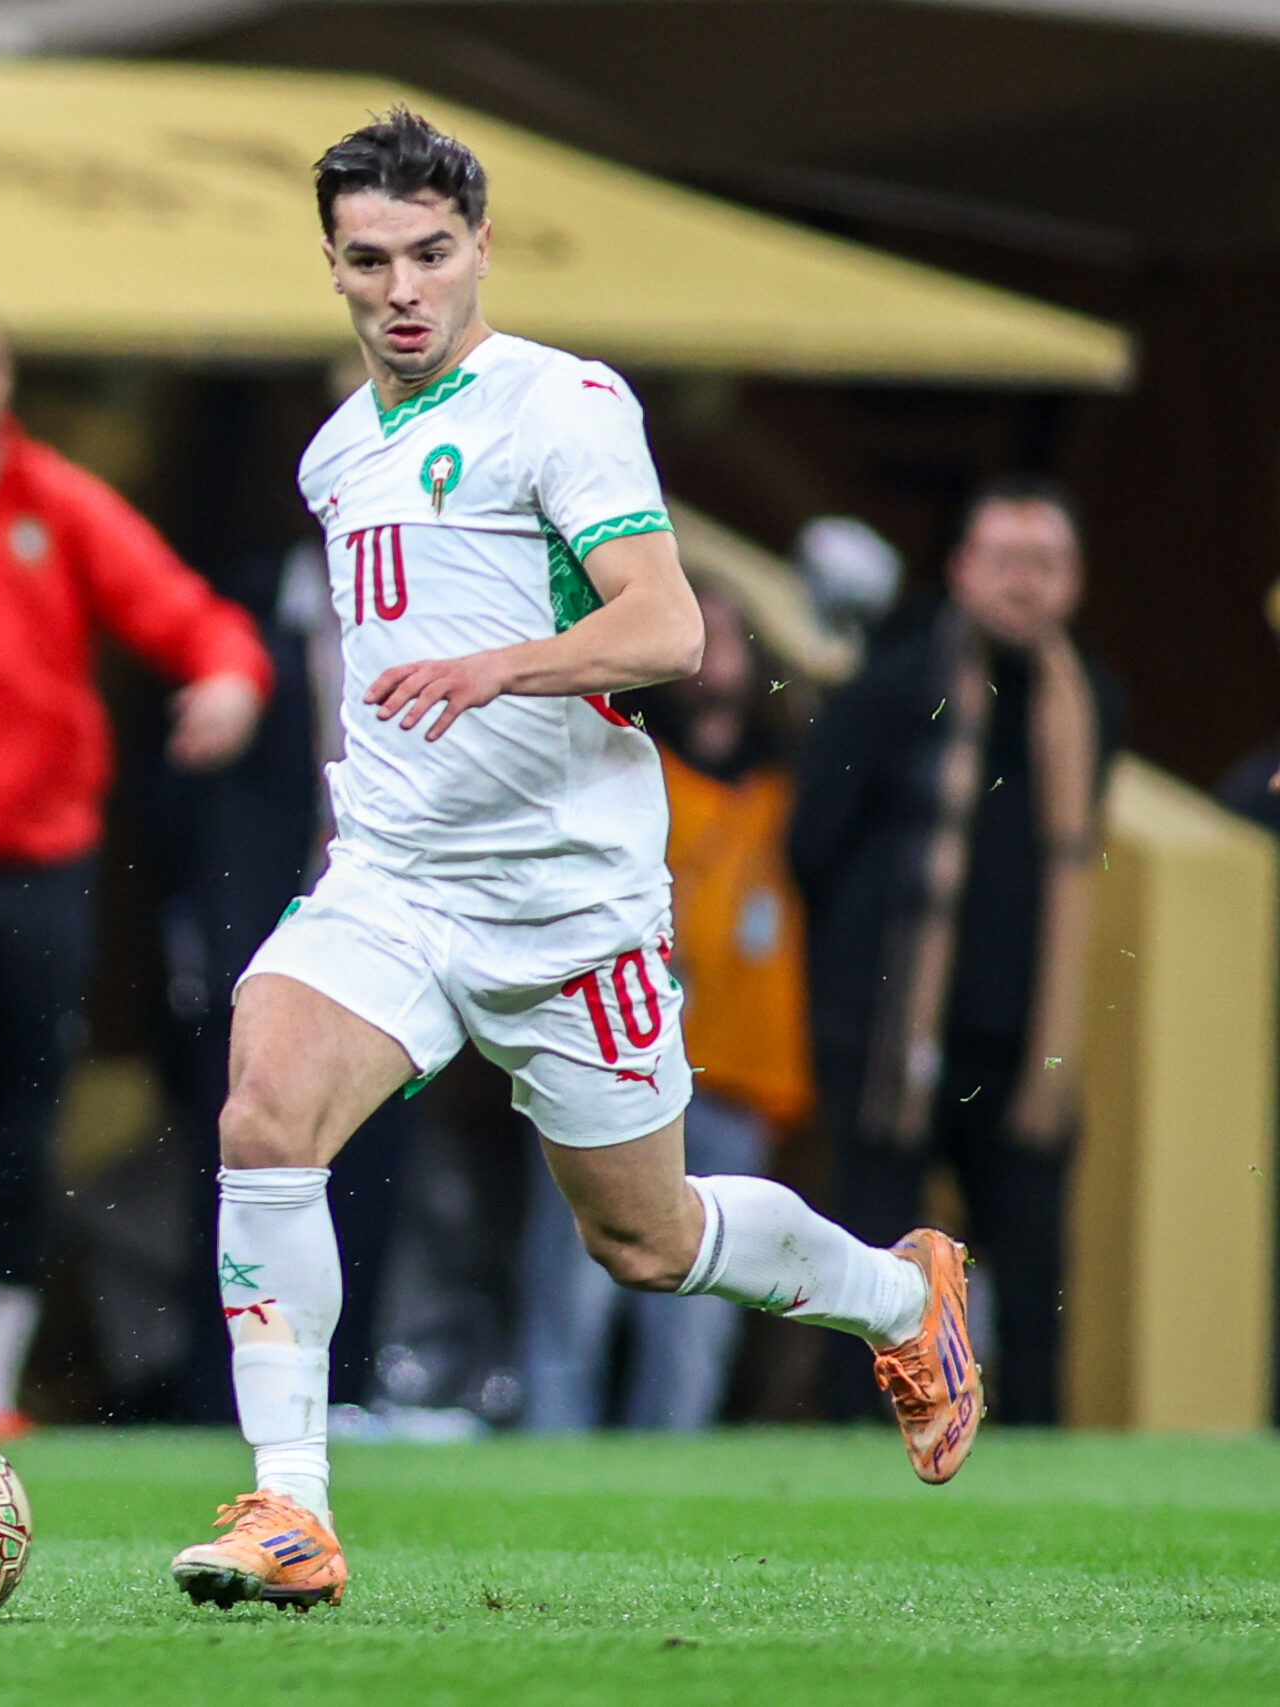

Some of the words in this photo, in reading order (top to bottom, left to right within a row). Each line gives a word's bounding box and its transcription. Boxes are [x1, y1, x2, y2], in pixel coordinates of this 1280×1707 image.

[346, 524, 407, 625] 10
[561, 949, 661, 1064] 10
[932, 1391, 973, 1475] F50
